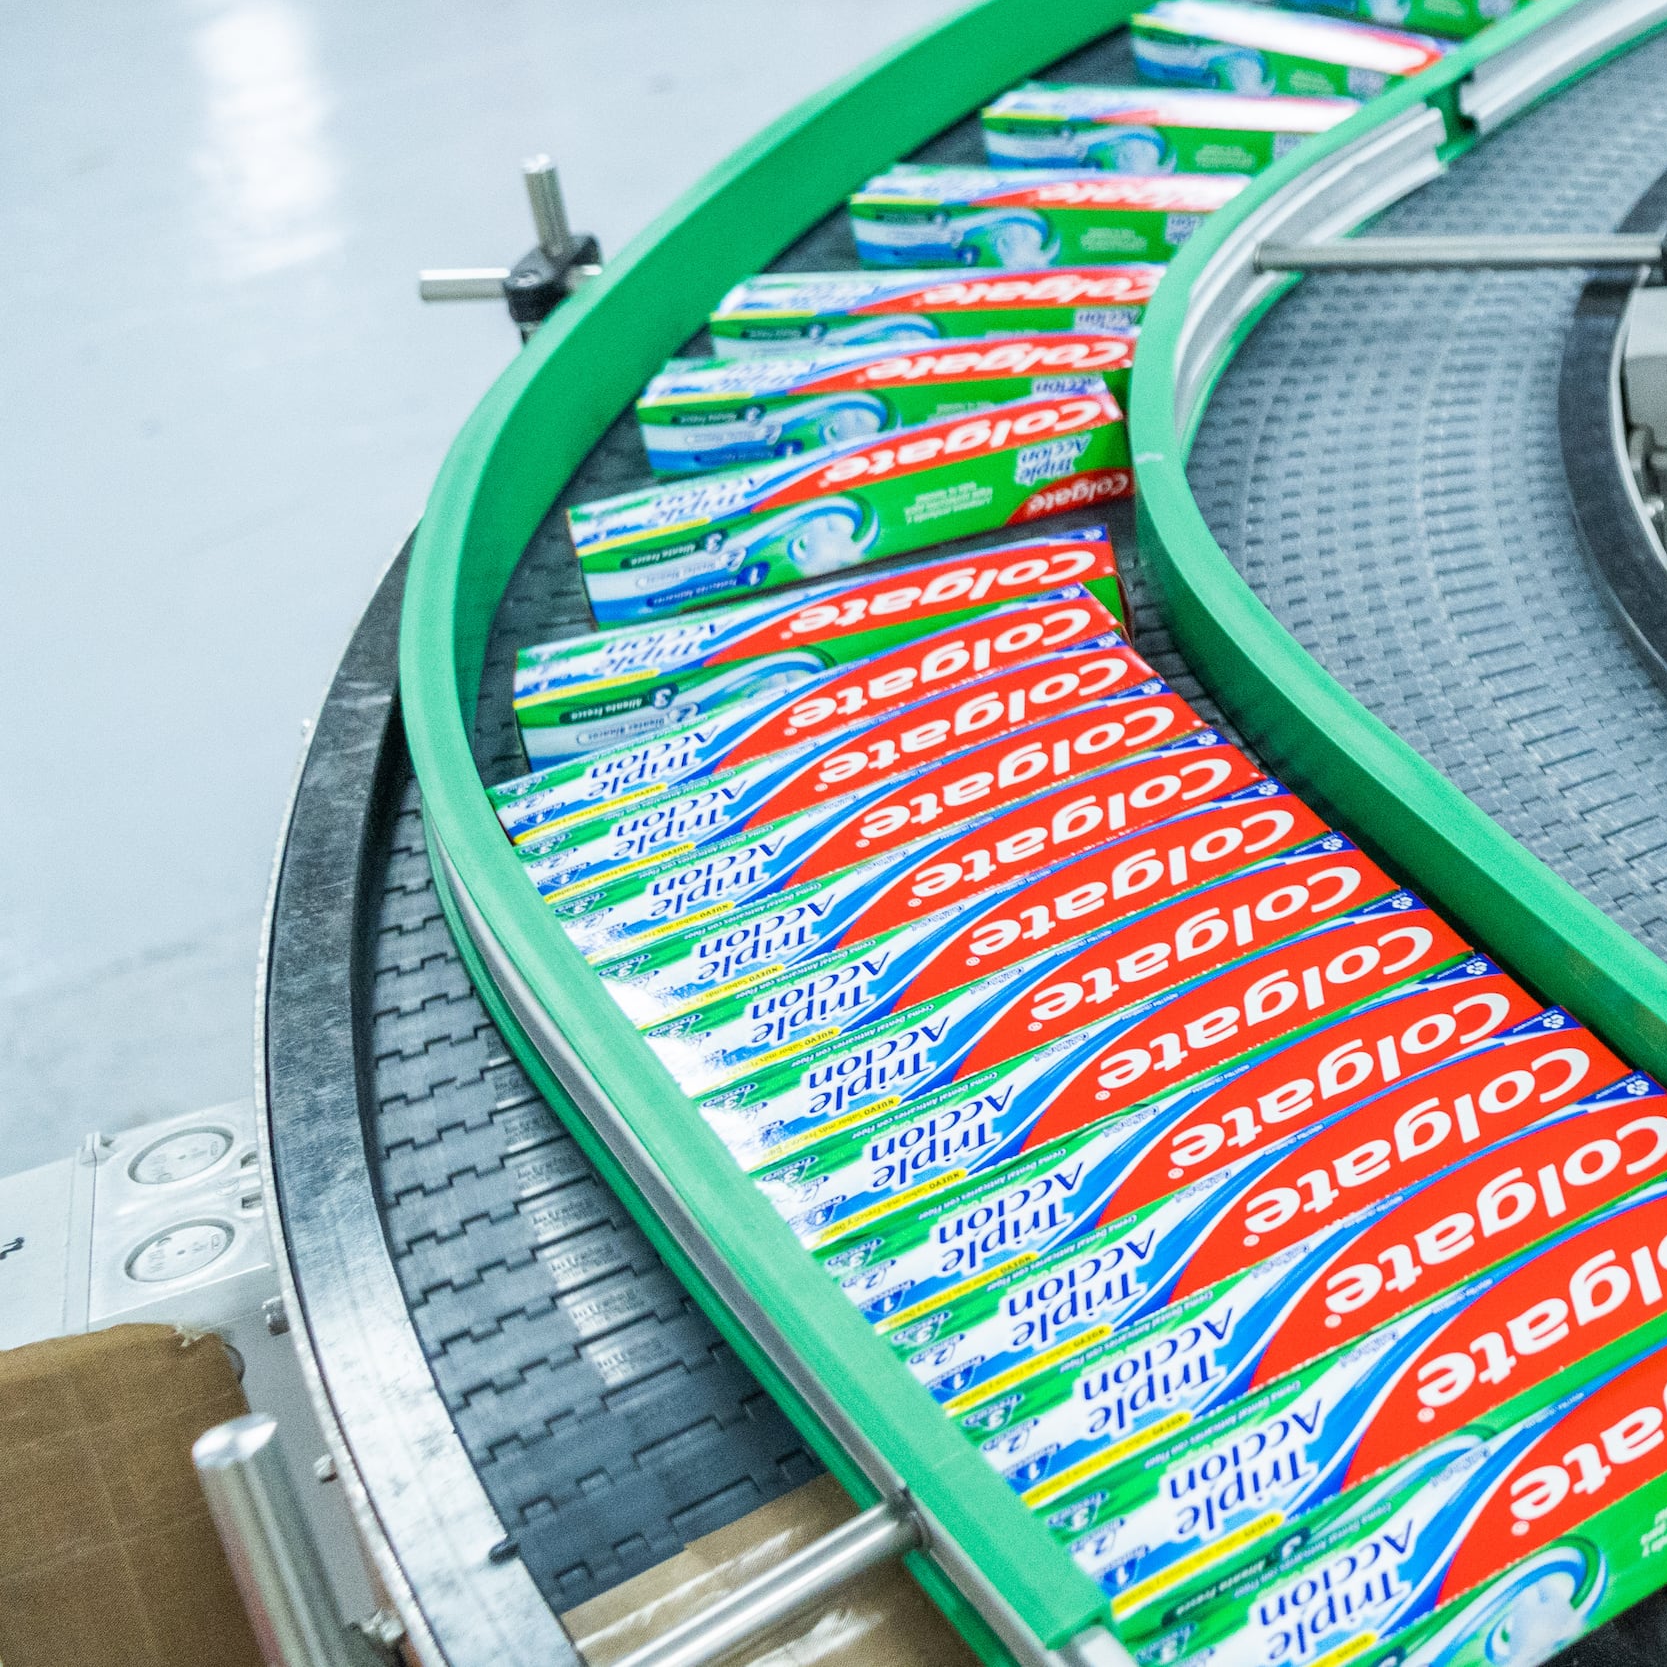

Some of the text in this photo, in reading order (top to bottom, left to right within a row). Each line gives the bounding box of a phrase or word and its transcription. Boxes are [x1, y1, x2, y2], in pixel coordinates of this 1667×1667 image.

[865, 340, 1128, 380] Colgate
[826, 401, 1101, 487] Colgate
[1021, 459, 1073, 483] Triple
[1030, 470, 1129, 514] Colgate
[789, 552, 1098, 632] Colgate
[655, 687, 671, 708] 3
[789, 612, 1087, 727] Colgate
[819, 658, 1127, 782] Colgate
[587, 750, 696, 797] Triple
[860, 707, 1174, 837] Colgate
[613, 807, 723, 856] Triple
[911, 759, 1231, 897] Colgate
[650, 864, 763, 916] Triple
[969, 809, 1293, 956] Colgate
[698, 893, 833, 957] Acción
[698, 925, 813, 980] Triple
[1030, 866, 1360, 1020] Colgate
[749, 964, 778, 982] NUEVO
[750, 949, 888, 1018] Acción
[751, 984, 869, 1043] Triple
[805, 1028, 834, 1048] NUEVO
[836, 1026, 874, 1052] Anticaries
[877, 1014, 905, 1034] Dental
[908, 1002, 932, 1021] Crema
[1097, 926, 1432, 1088] Colgate
[807, 1015, 948, 1087] Acción
[808, 1051, 929, 1113] Triple
[816, 1044, 833, 1058] con
[971, 1070, 996, 1089] Crema
[1170, 993, 1509, 1166] Colgate
[864, 1096, 894, 1116] NUEVO
[868, 1084, 1012, 1160] Acción
[877, 1114, 894, 1129] con
[897, 1095, 936, 1122] Anticaries
[939, 1082, 968, 1103] Dental
[872, 1122, 995, 1187] Triple
[1244, 1048, 1589, 1232] Colgate
[929, 1169, 960, 1191] NUEVO
[936, 1161, 1082, 1243] Acción
[941, 1201, 1066, 1272] Triple
[883, 1295, 893, 1312] 1
[1005, 1228, 1154, 1315] Acción
[1011, 1271, 1140, 1346] Triple
[953, 1371, 963, 1390] 1
[1080, 1306, 1231, 1399] Acción
[1088, 1353, 1219, 1434] Triple
[1029, 1460, 1039, 1480] 1
[1166, 1398, 1320, 1498] Acción
[1176, 1448, 1311, 1535] Triple
[1256, 1519, 1411, 1625] Acción
[1268, 1569, 1403, 1661] Triple
